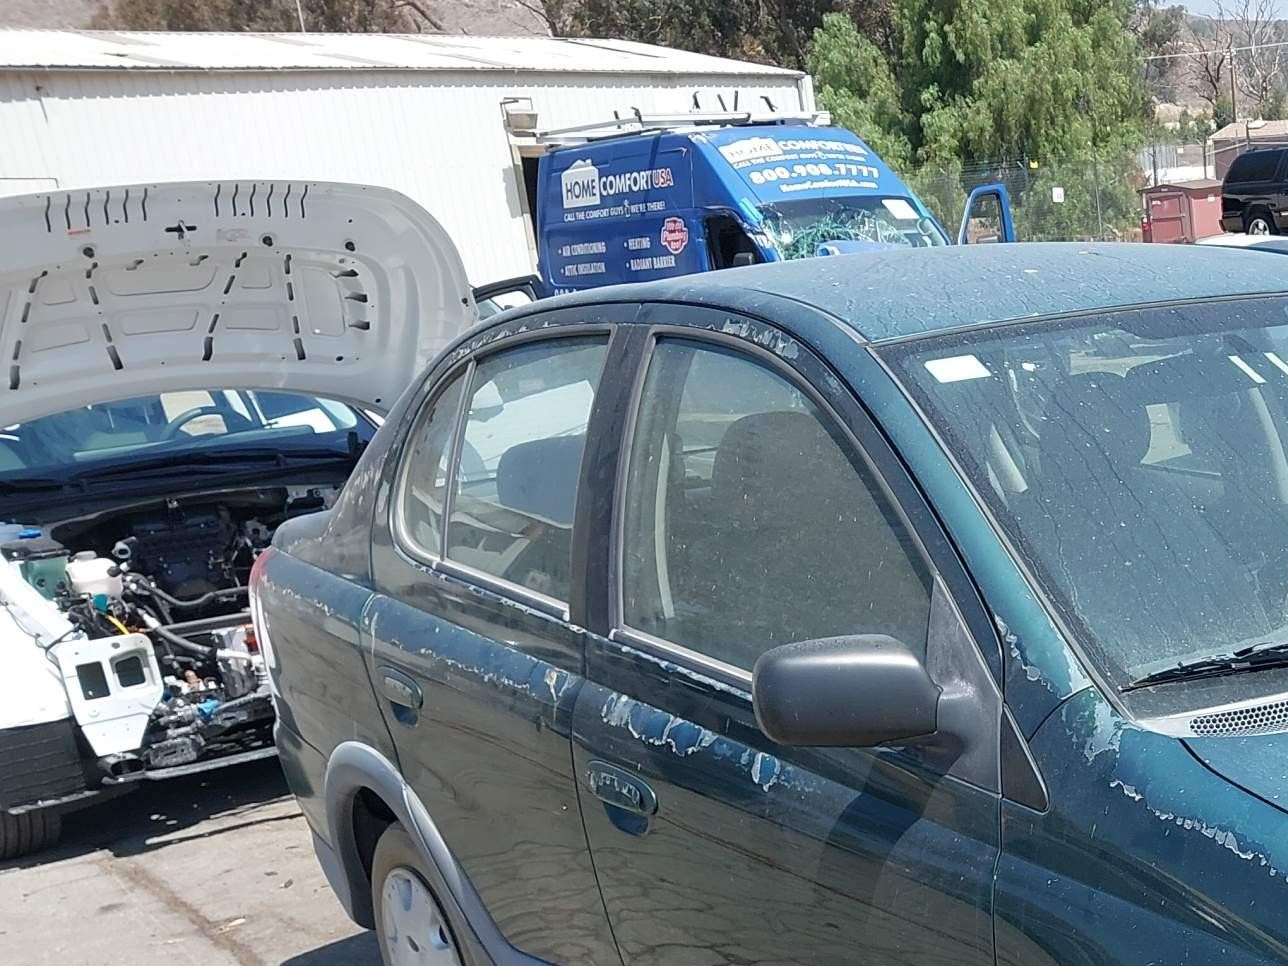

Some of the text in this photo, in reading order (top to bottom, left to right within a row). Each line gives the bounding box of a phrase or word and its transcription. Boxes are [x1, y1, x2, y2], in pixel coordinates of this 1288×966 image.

[566, 179, 597, 200] HOME
[564, 212, 576, 222] CALL
[576, 211, 585, 220] THE
[585, 208, 609, 219] COMFORT
[628, 237, 651, 250] HEATING
